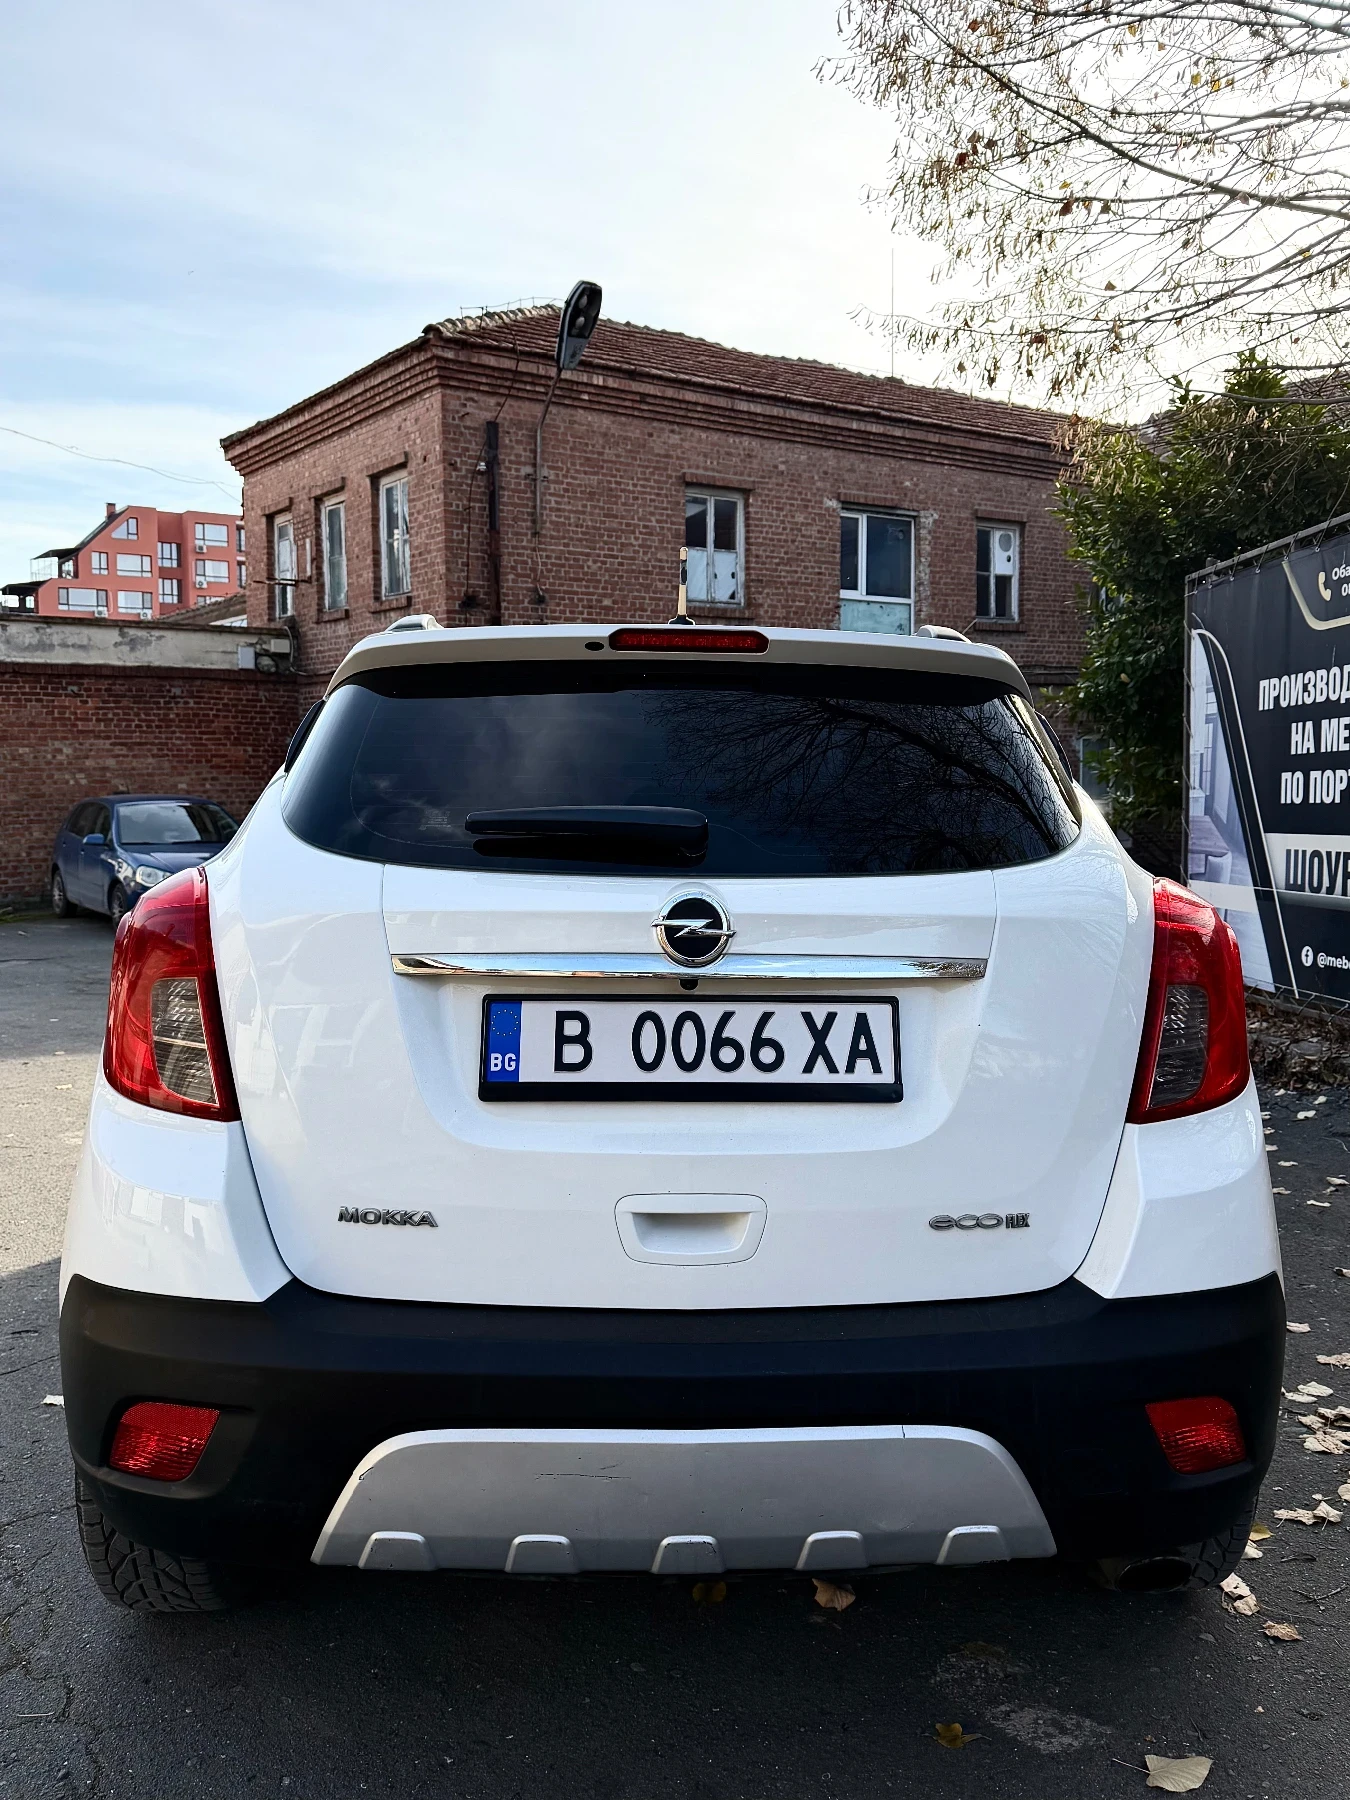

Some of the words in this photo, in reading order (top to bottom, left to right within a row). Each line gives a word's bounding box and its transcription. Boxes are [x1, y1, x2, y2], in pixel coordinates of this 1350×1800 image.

[1290, 720, 1316, 755] НА
[1320, 716, 1350, 753] МЕ
[1280, 770, 1304, 804] ПО
[1308, 768, 1350, 804] ПОР
[1317, 952, 1350, 970] @meb
[553, 1010, 594, 1073] B
[630, 1010, 786, 1073] 0066
[799, 1011, 884, 1074] XA
[490, 1052, 517, 1072] BG
[337, 1205, 439, 1228] MOKKA
